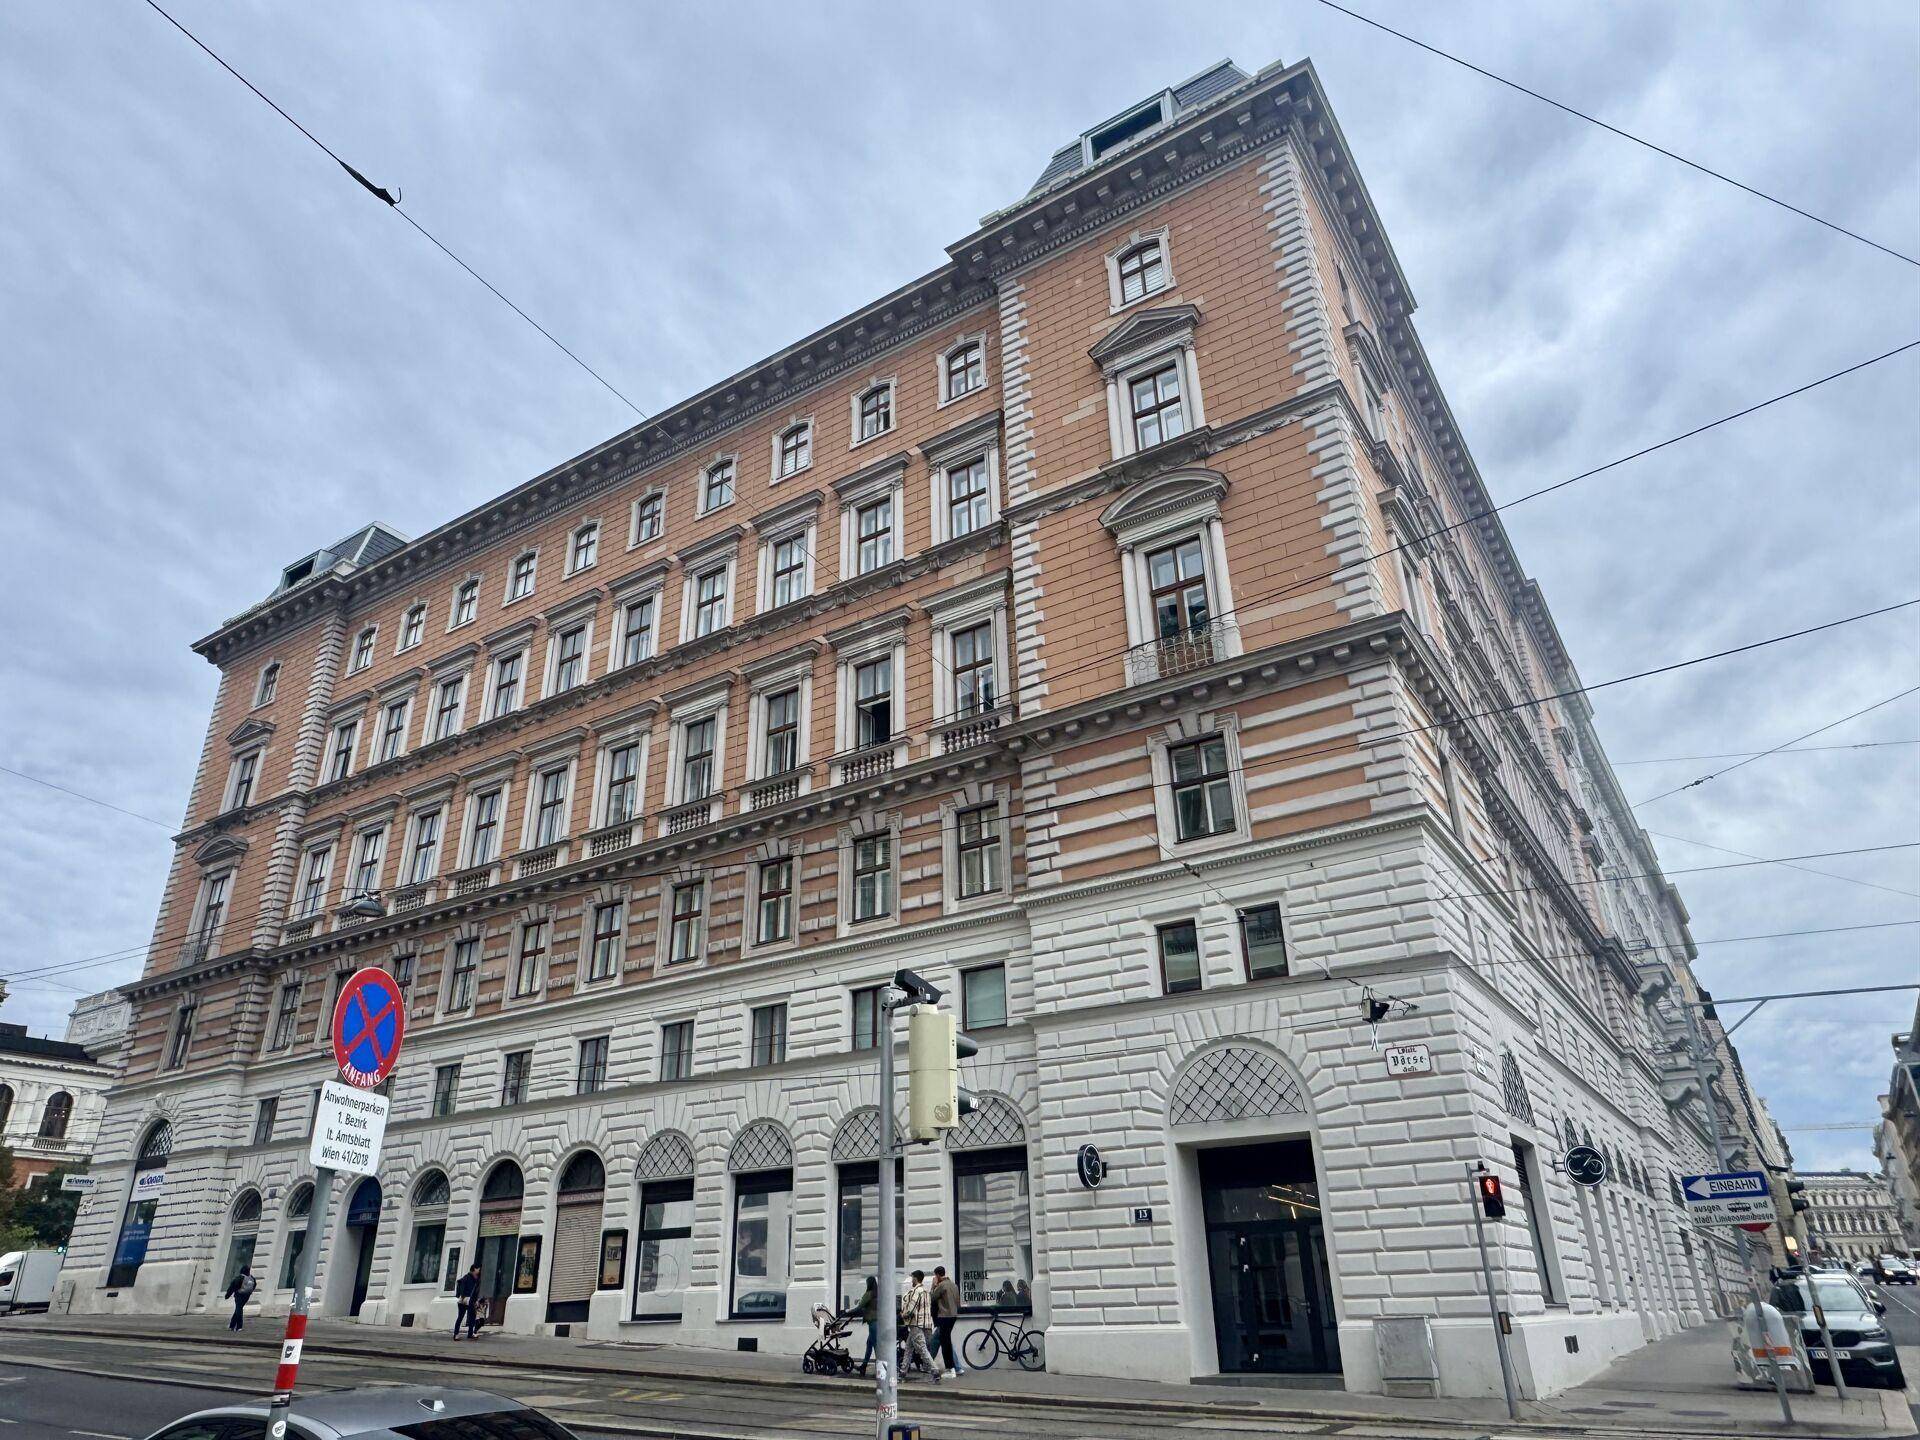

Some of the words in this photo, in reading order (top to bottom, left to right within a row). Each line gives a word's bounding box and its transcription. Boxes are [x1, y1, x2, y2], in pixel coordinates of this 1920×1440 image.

[342, 1061, 381, 1087] ANFANG
[324, 1089, 385, 1117] Anwohnerparken
[338, 1111, 343, 1124] 1.
[345, 1113, 368, 1130] Bezirk
[326, 1127, 334, 1141] lt.
[335, 1129, 371, 1149] Amtsblatt
[322, 1145, 340, 1161] Wien
[341, 1149, 369, 1167] 41/2018
[1709, 1178, 1758, 1192] EINBAHN
[963, 1281, 976, 1291] FUN
